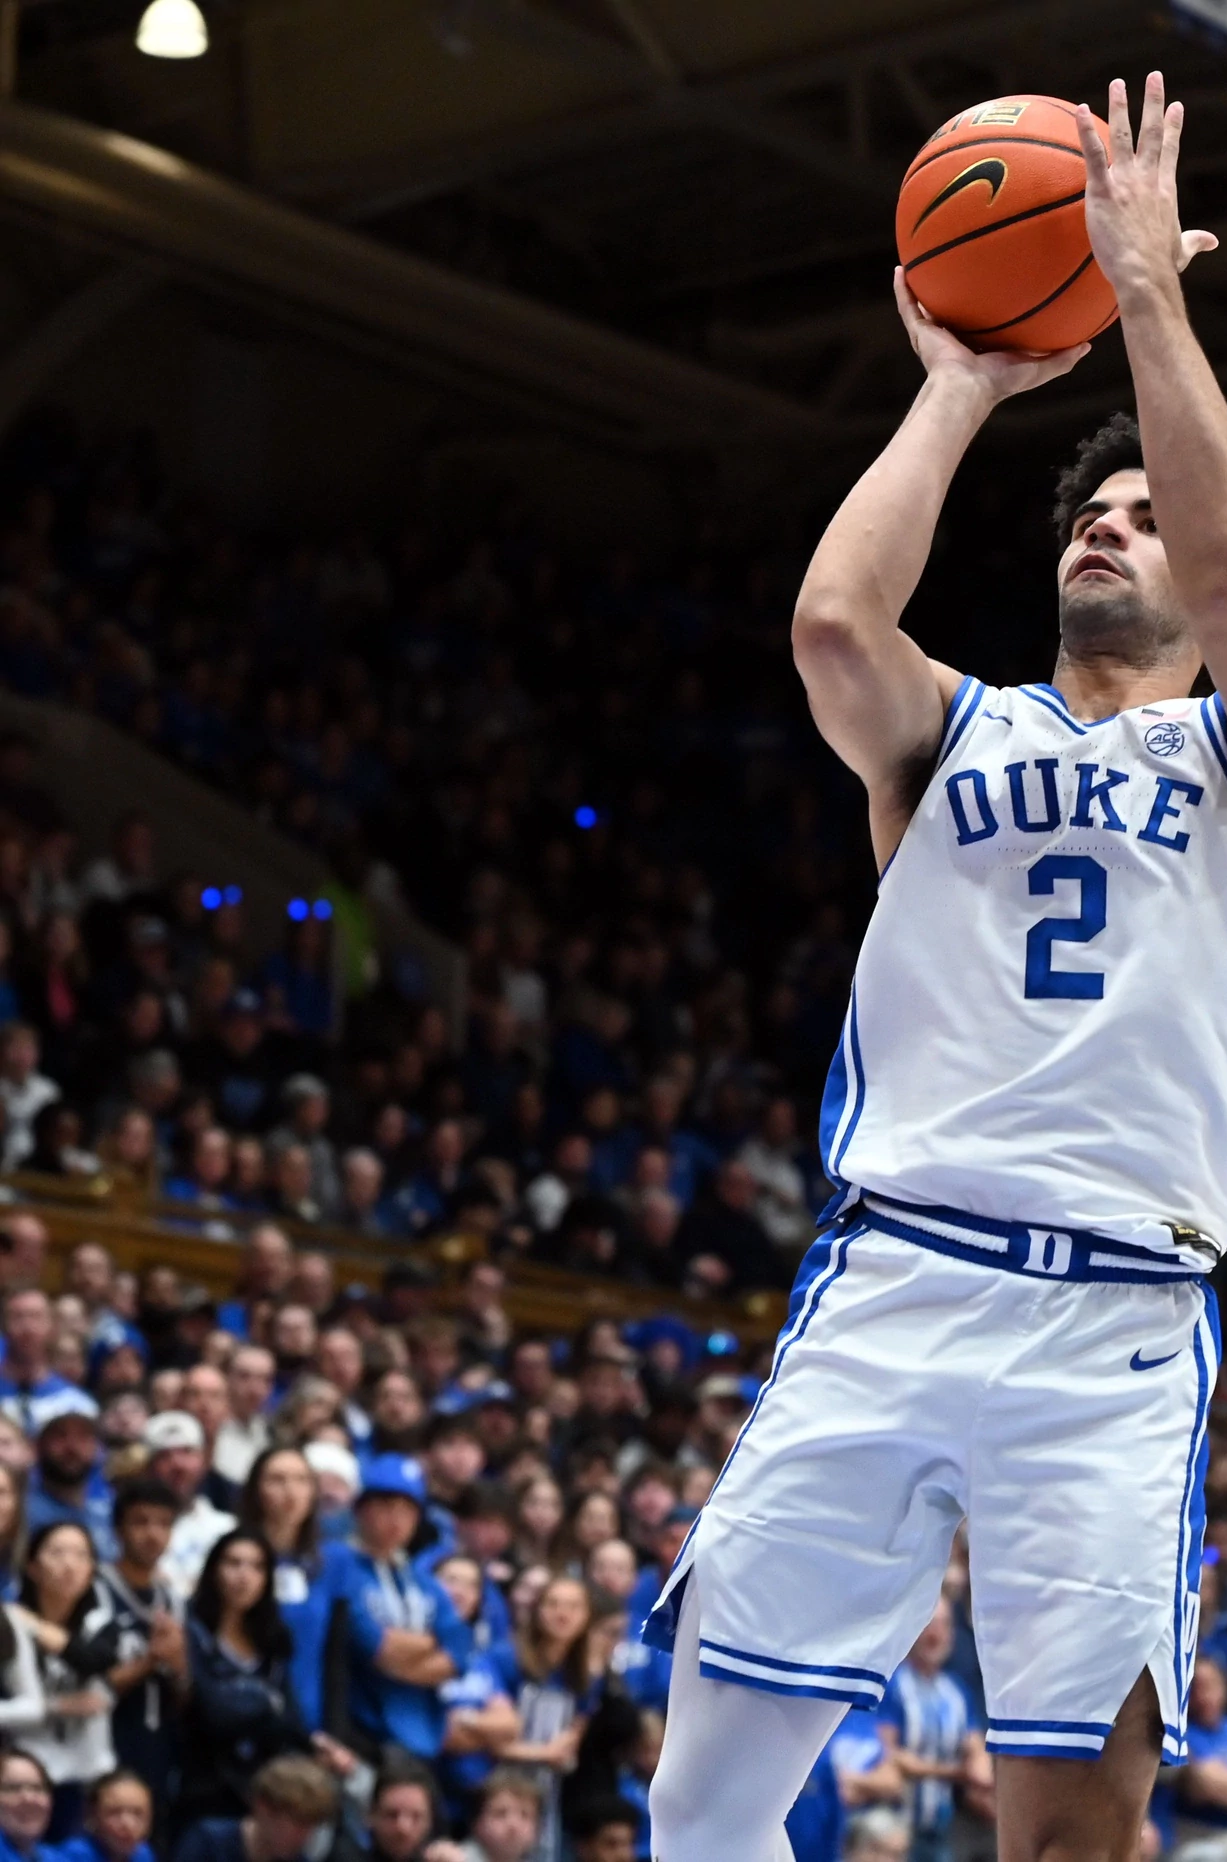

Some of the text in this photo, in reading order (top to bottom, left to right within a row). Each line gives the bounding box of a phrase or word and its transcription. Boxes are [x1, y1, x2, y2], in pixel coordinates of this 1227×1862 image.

[945, 758, 1204, 853] DUKE
[1024, 855, 1108, 1000] 2
[1023, 1228, 1073, 1276] D
